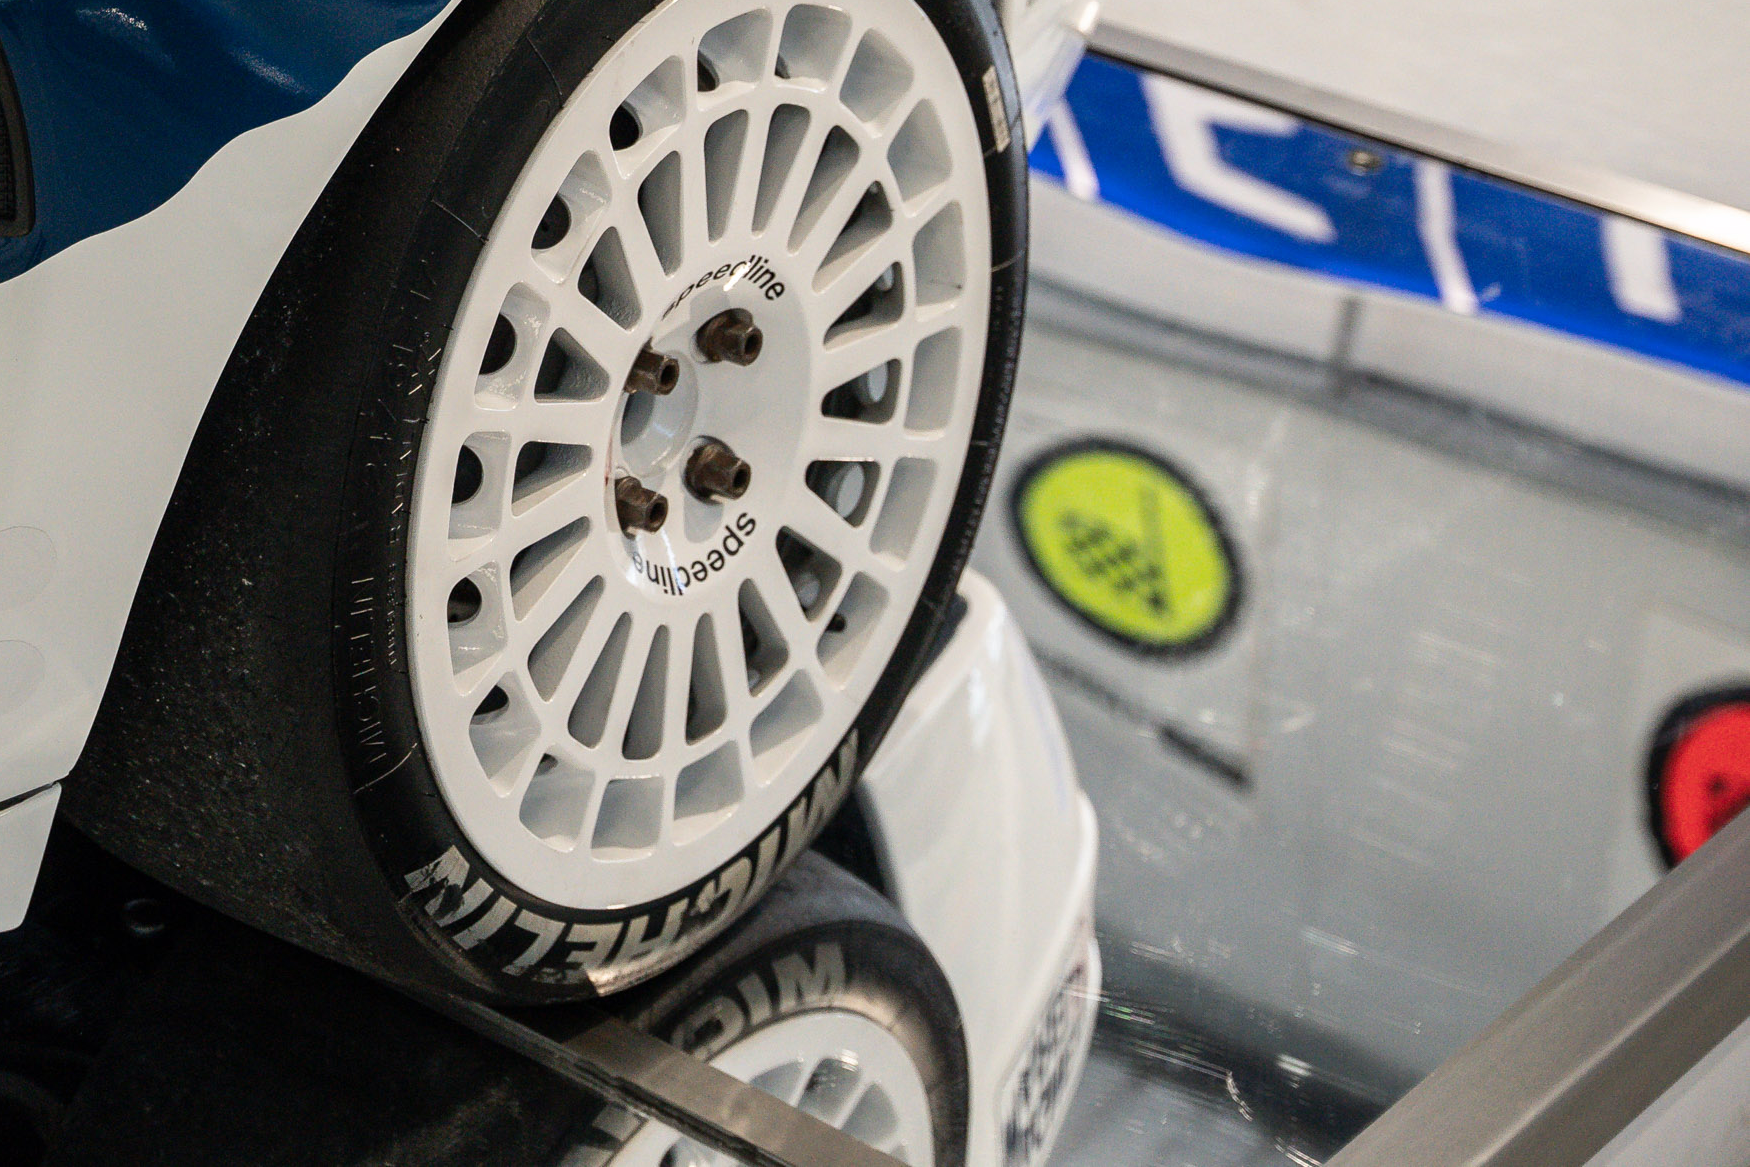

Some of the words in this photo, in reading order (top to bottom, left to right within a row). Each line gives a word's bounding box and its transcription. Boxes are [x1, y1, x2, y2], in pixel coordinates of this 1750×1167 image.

[661, 254, 786, 322] speedline
[632, 510, 757, 597] speedline
[402, 727, 858, 992] MICHELIN
